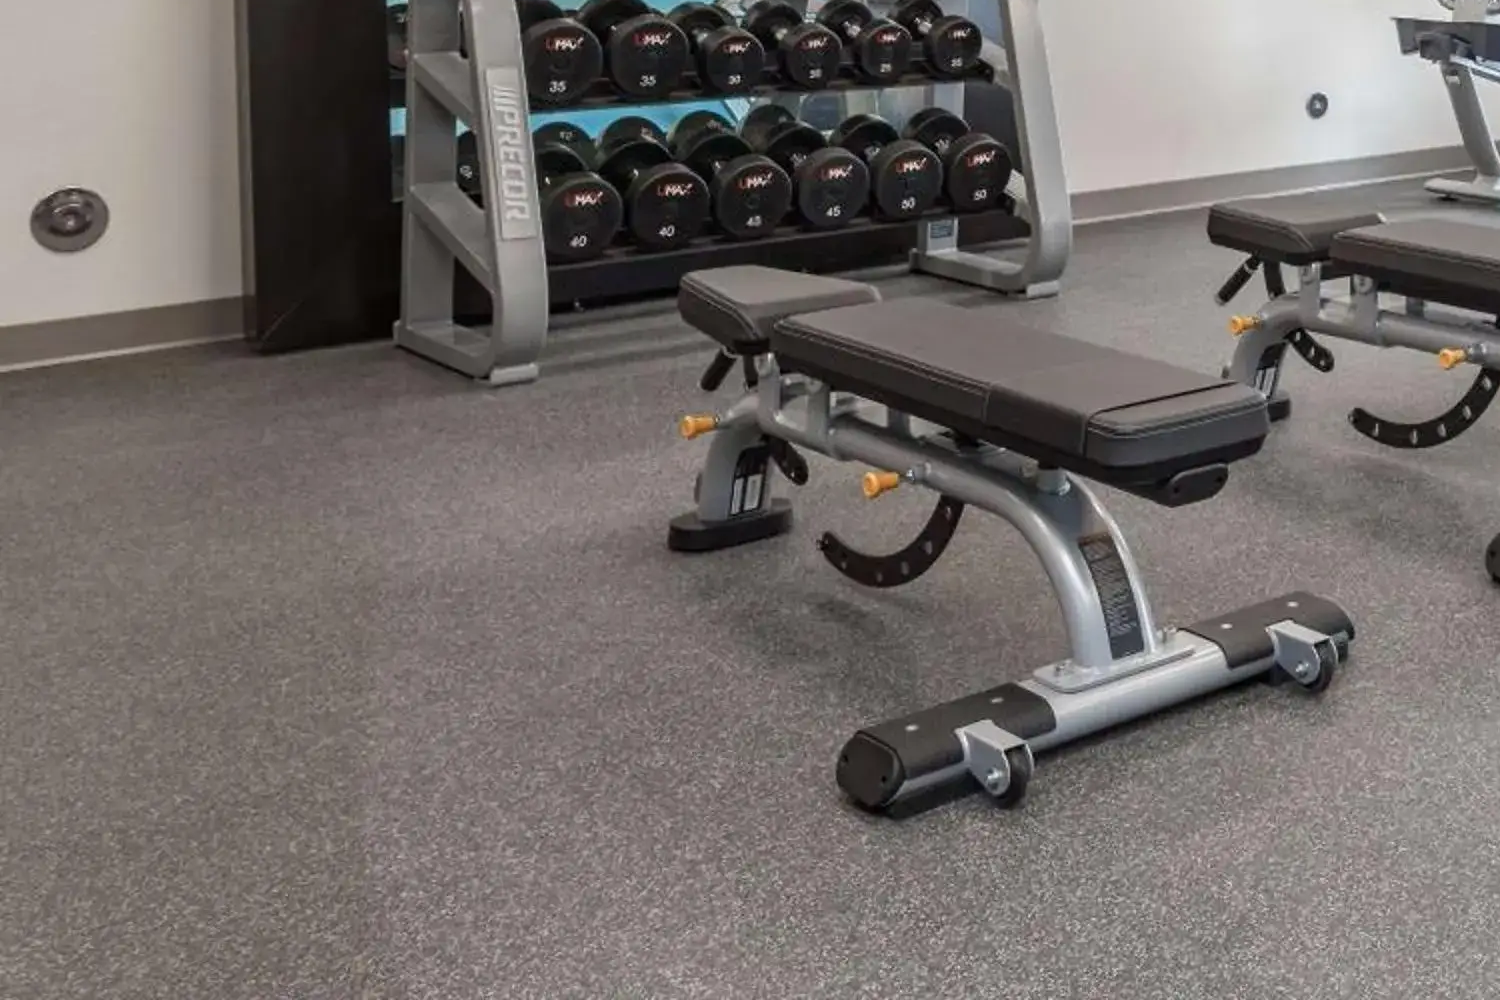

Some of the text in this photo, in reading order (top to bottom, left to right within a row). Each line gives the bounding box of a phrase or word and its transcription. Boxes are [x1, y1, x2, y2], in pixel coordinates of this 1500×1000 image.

[549, 79, 567, 93] 35
[639, 75, 657, 88] 35
[495, 103, 531, 220] PRECOR
[826, 205, 842, 218] 45
[658, 224, 676, 238] 40
[568, 234, 588, 249] 40
